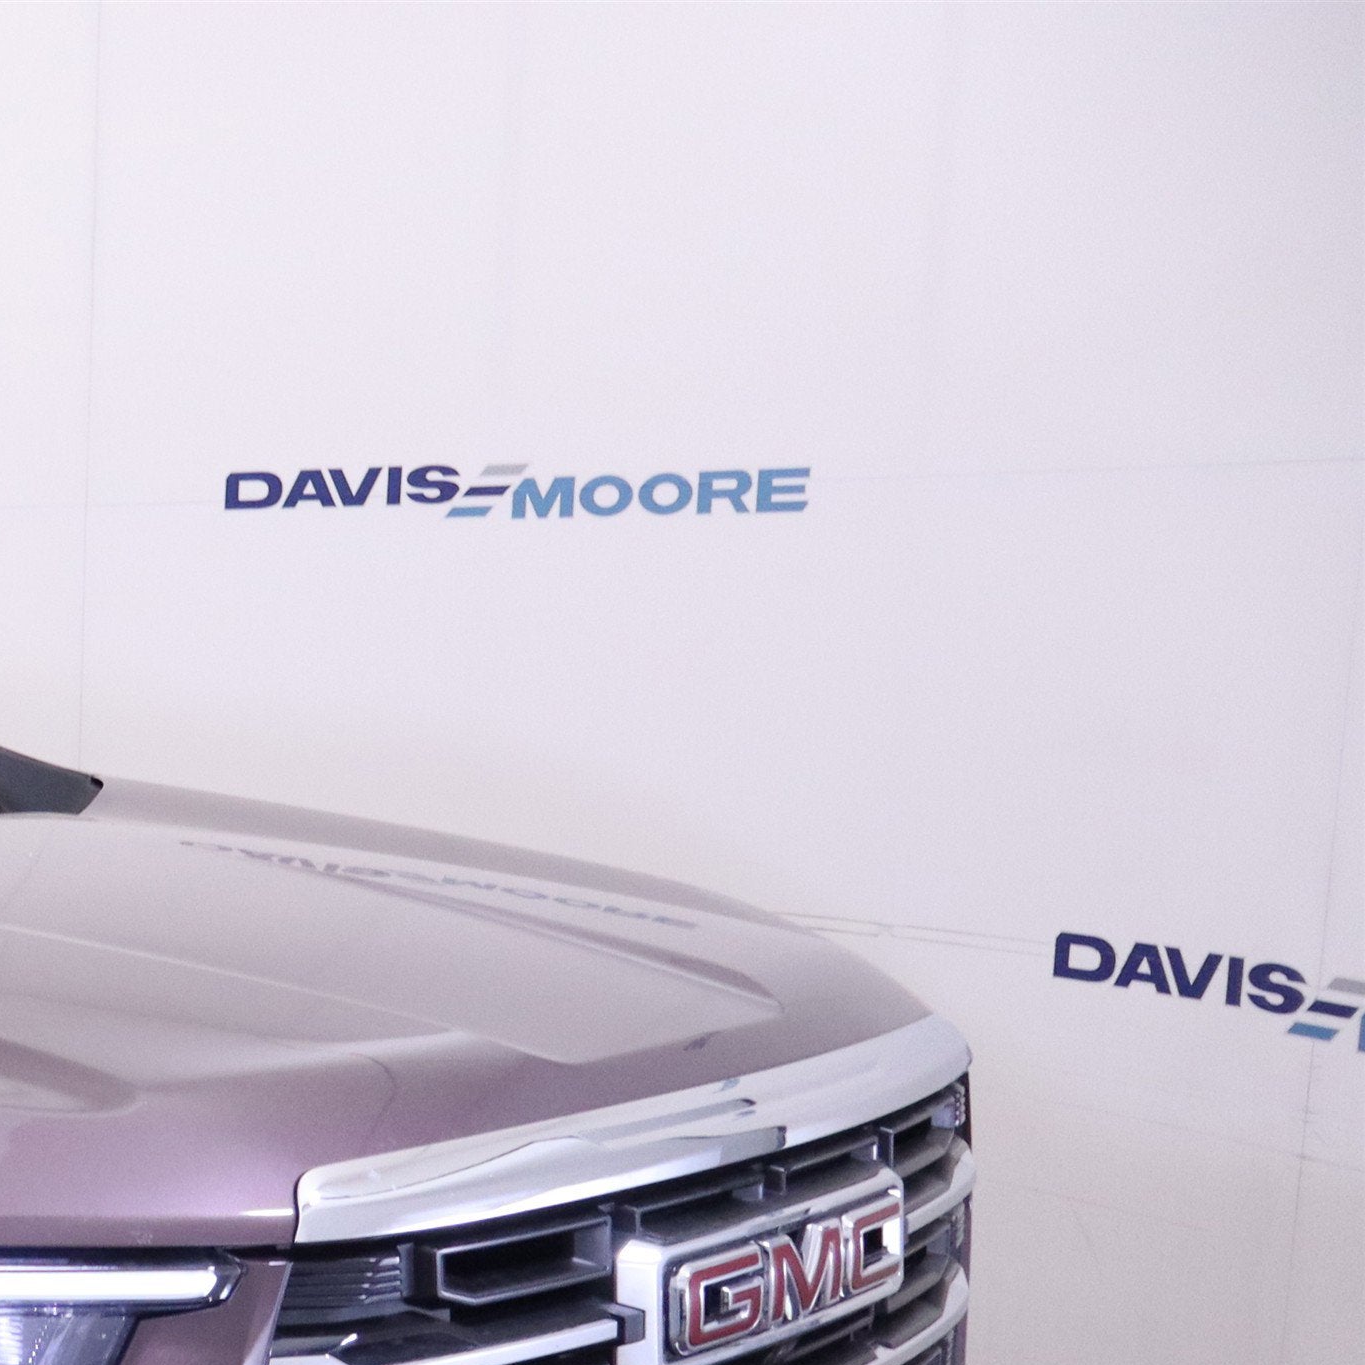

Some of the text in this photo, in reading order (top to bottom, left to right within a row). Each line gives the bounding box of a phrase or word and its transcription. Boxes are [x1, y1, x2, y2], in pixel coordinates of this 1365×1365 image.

[224, 464, 812, 519] DAVIS MOORE
[1053, 931, 1307, 1015] DAVIS
[675, 1196, 901, 1353] GMC
